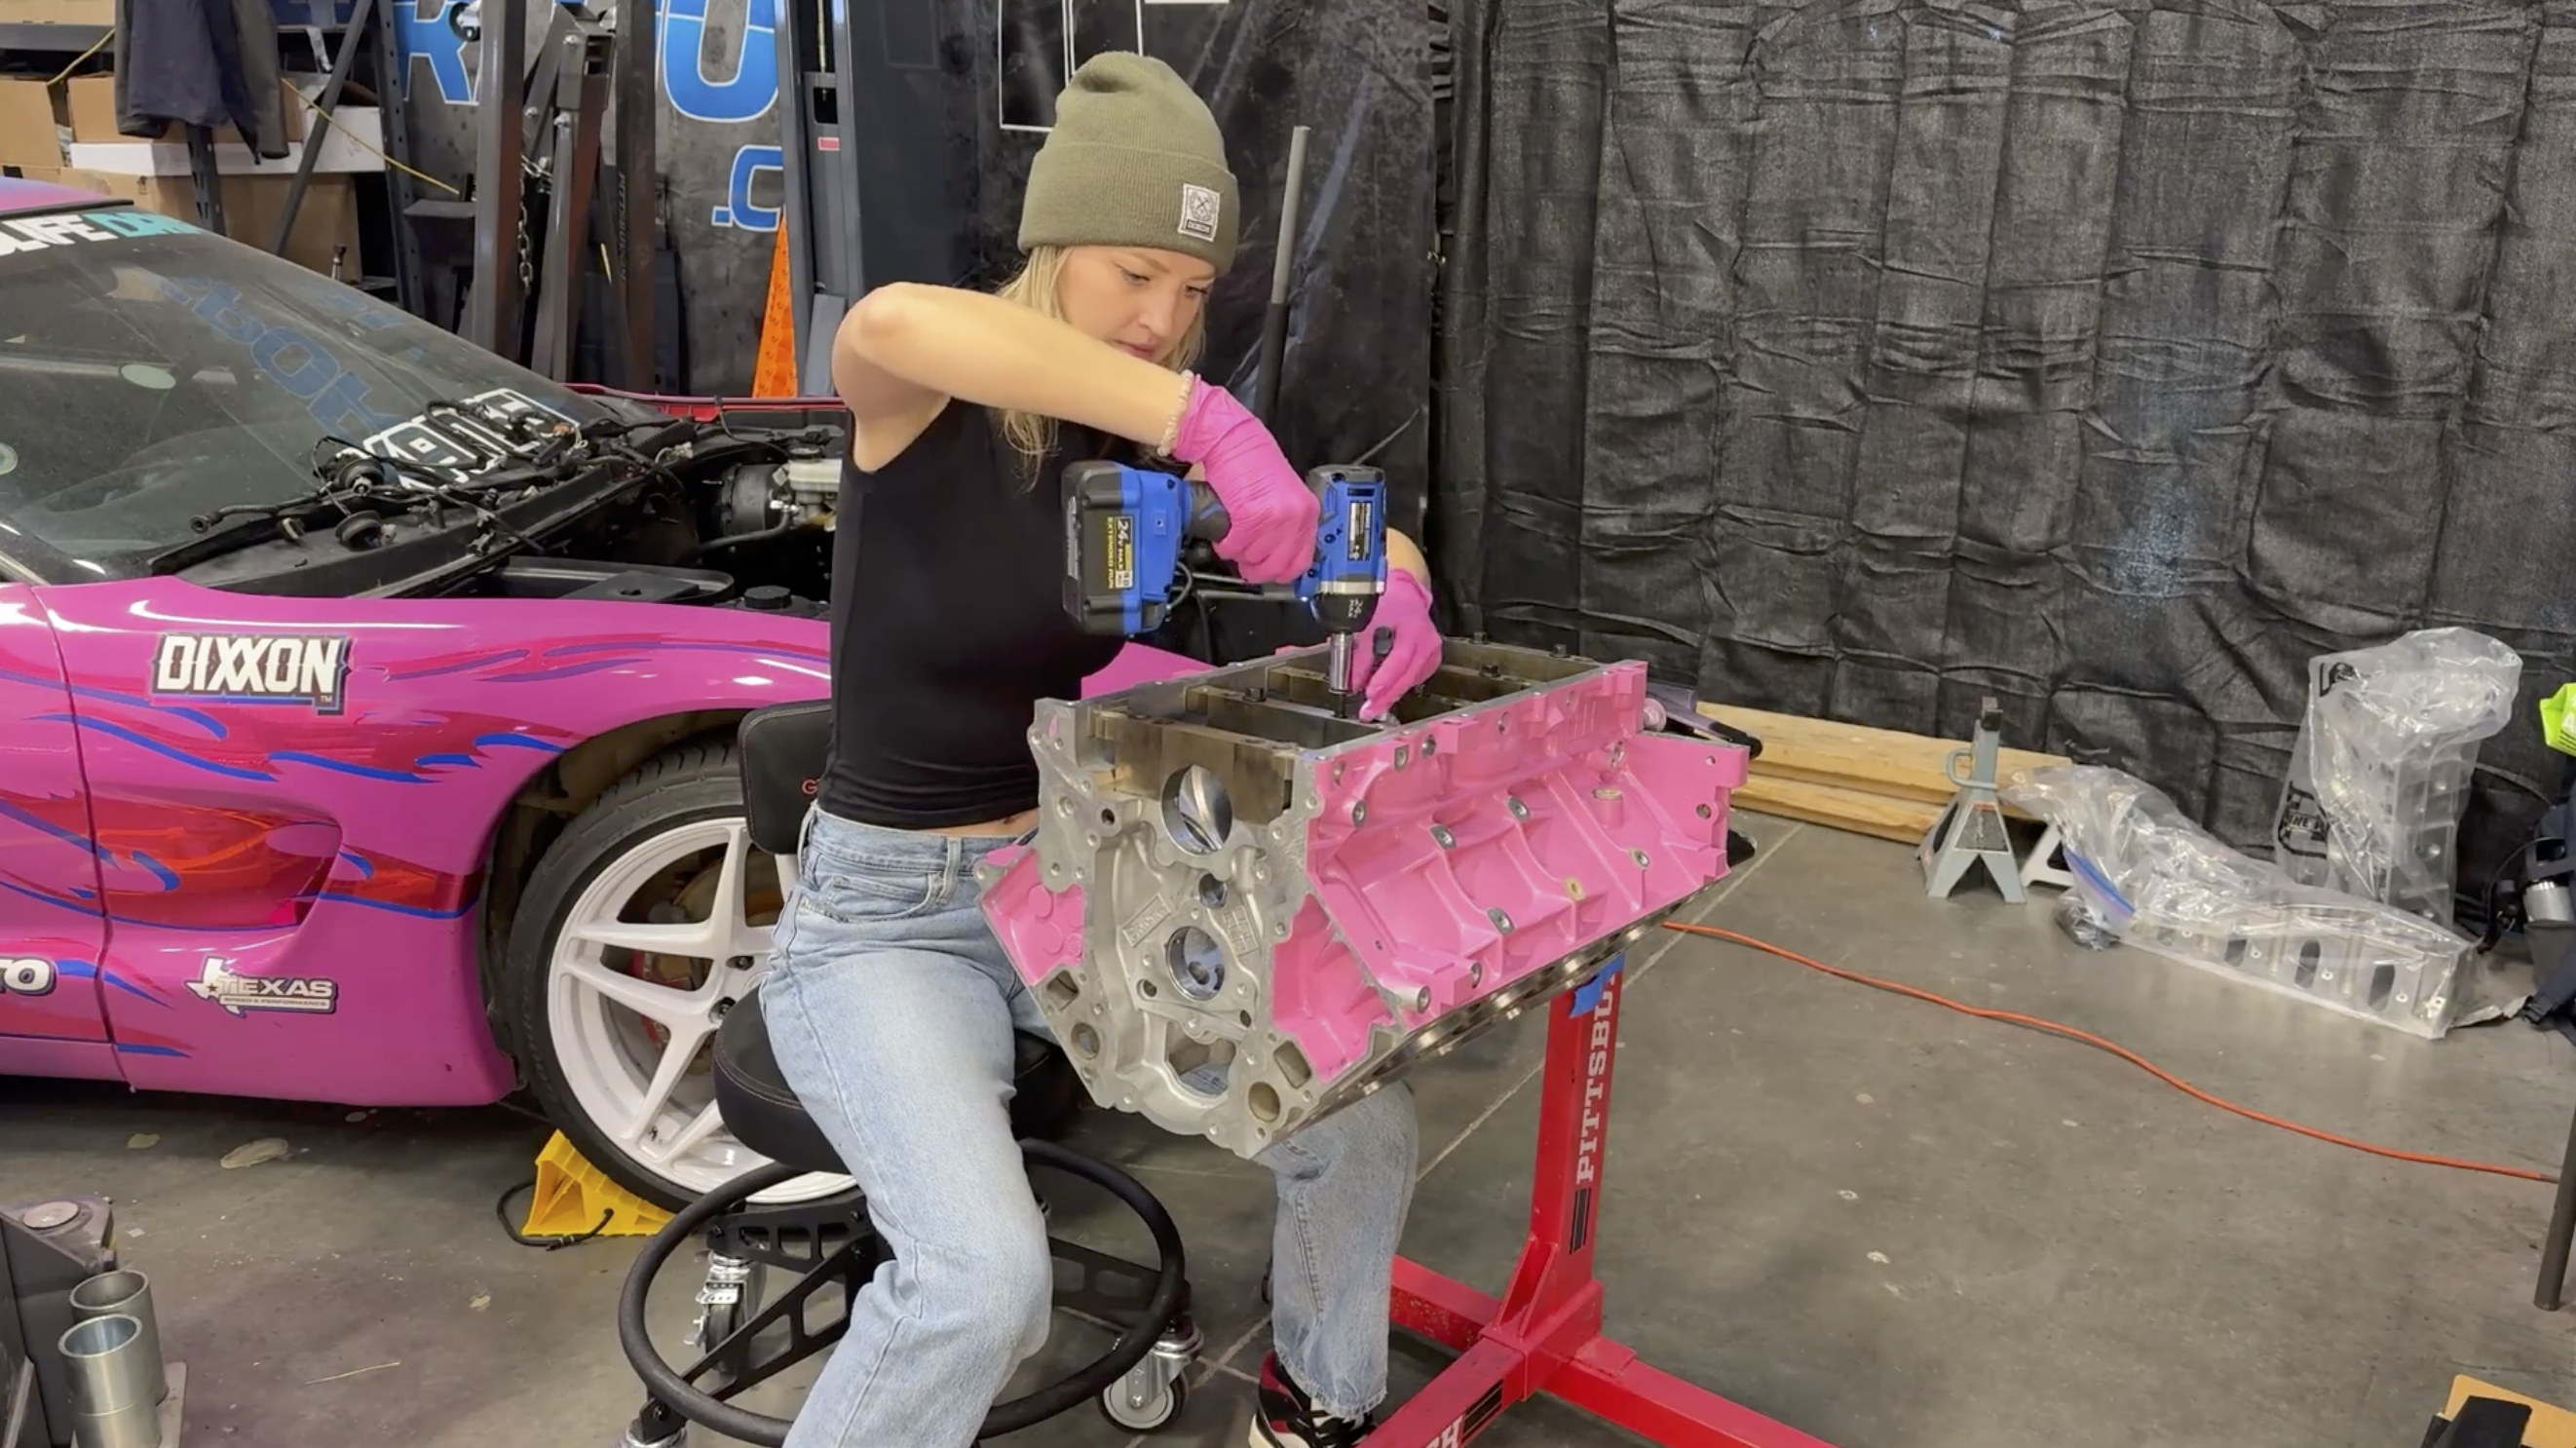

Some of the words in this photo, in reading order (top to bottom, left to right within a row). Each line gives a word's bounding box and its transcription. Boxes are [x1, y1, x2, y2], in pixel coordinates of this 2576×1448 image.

[157, 635, 341, 694] DIXXON
[218, 977, 333, 997] TEXAS
[1575, 973, 1616, 1184] PITTSBU
